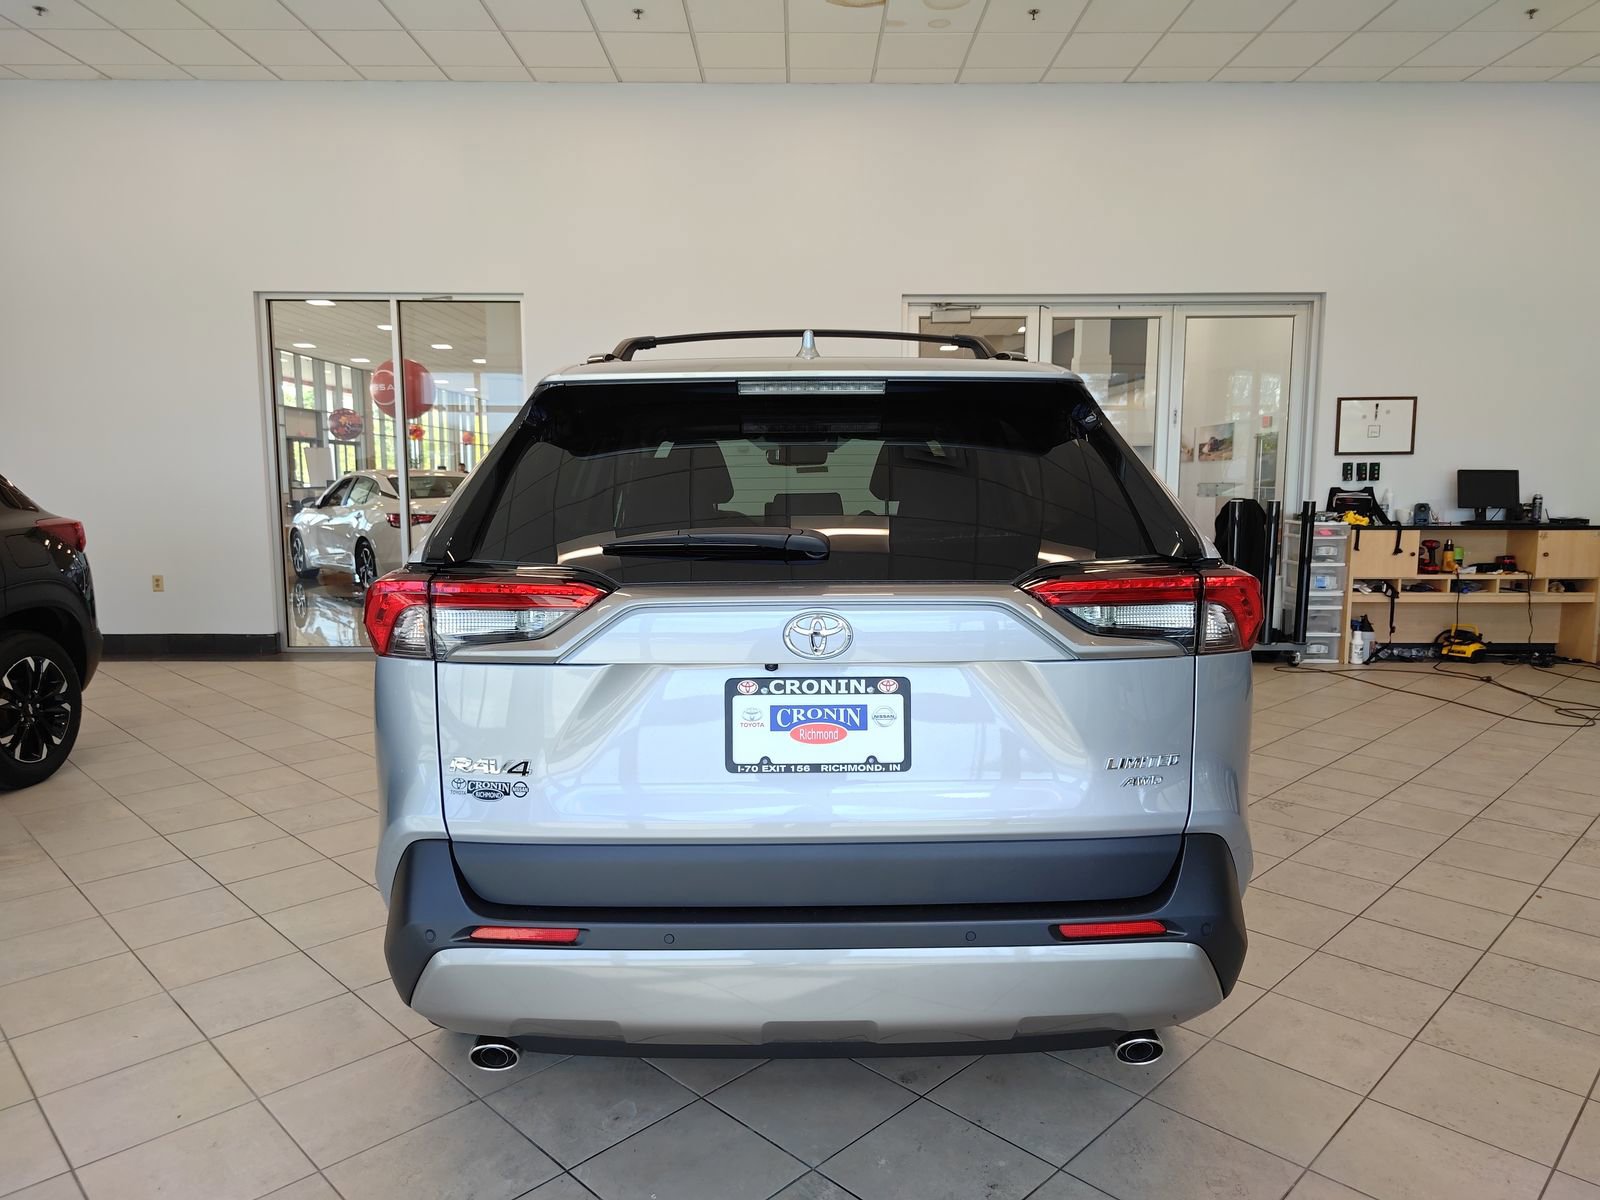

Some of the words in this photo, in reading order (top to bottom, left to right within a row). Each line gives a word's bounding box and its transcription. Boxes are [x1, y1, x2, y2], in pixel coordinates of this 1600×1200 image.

[768, 679, 866, 695] CRONIN
[776, 707, 862, 728] CRONIN
[799, 728, 839, 741] Richmond
[737, 765, 759, 773] I-70
[762, 765, 786, 773] EXIT
[820, 764, 886, 772] RICHMOND,
[1106, 754, 1180, 770] LIMITED
[468, 781, 511, 794] CRONIN
[1120, 775, 1163, 787] AWD
[475, 790, 502, 799] RICHMOND
